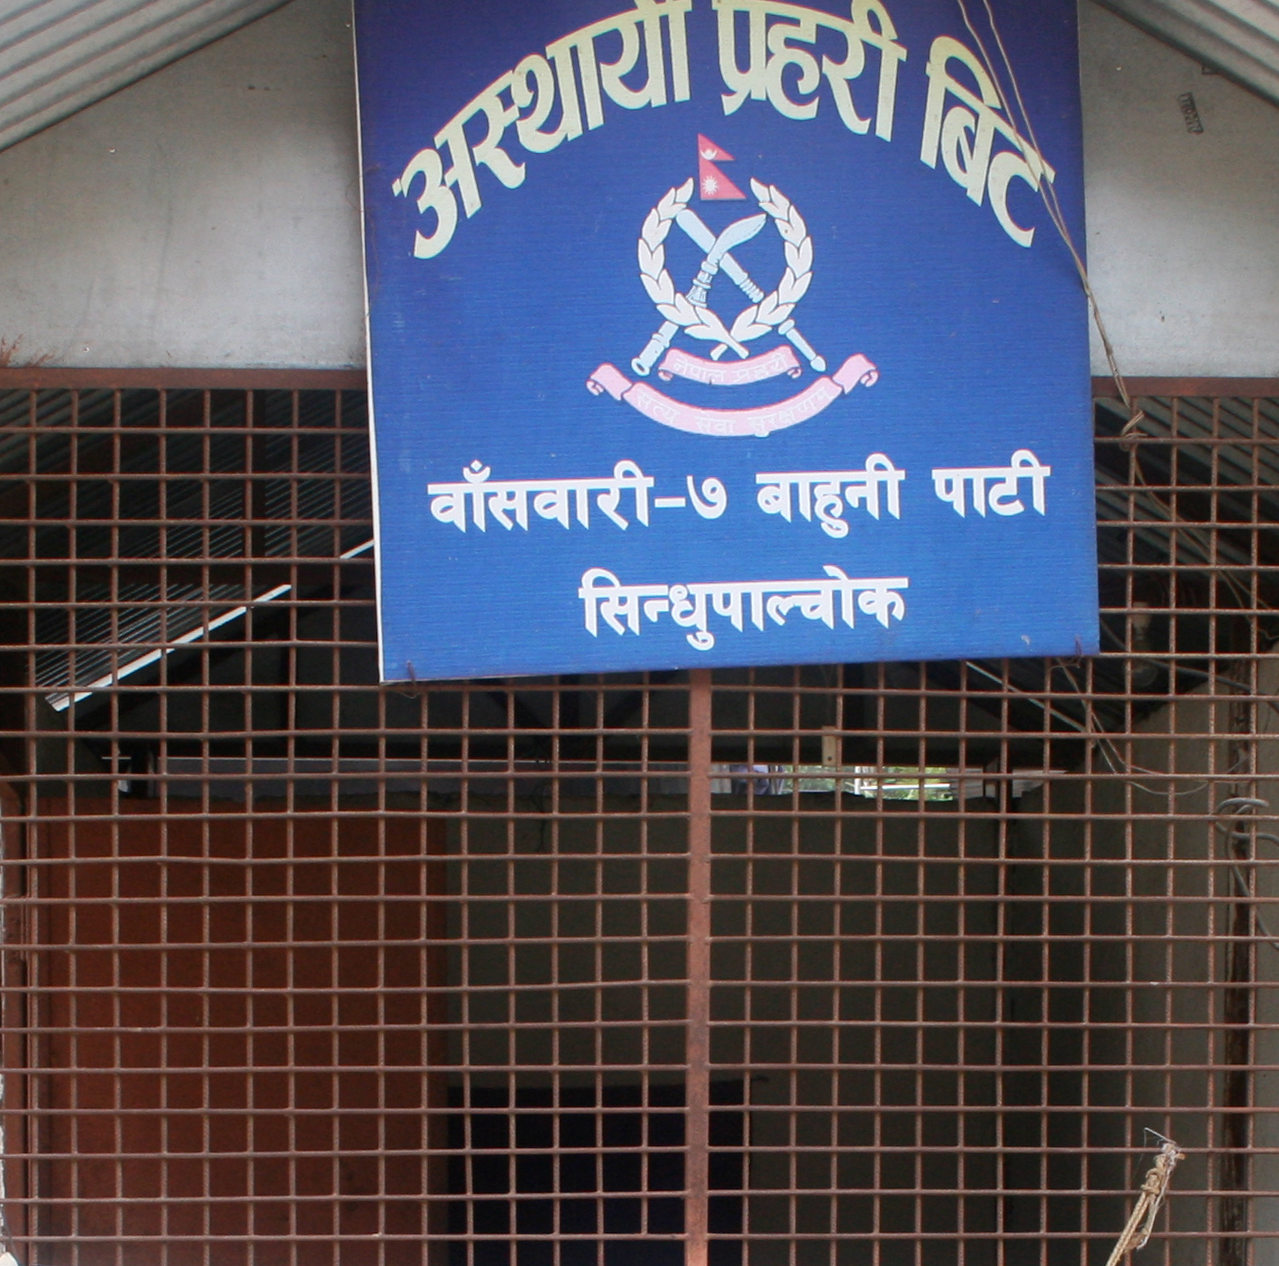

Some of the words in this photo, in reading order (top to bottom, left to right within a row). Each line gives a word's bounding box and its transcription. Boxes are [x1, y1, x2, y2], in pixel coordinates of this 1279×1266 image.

[711, 0, 907, 141] प्रहरी
[919, 36, 1056, 247] बिट
[756, 453, 906, 538] बाहुनी
[932, 449, 1052, 517] पाटी
[579, 565, 909, 651] सिन्धुपाल्चोक
